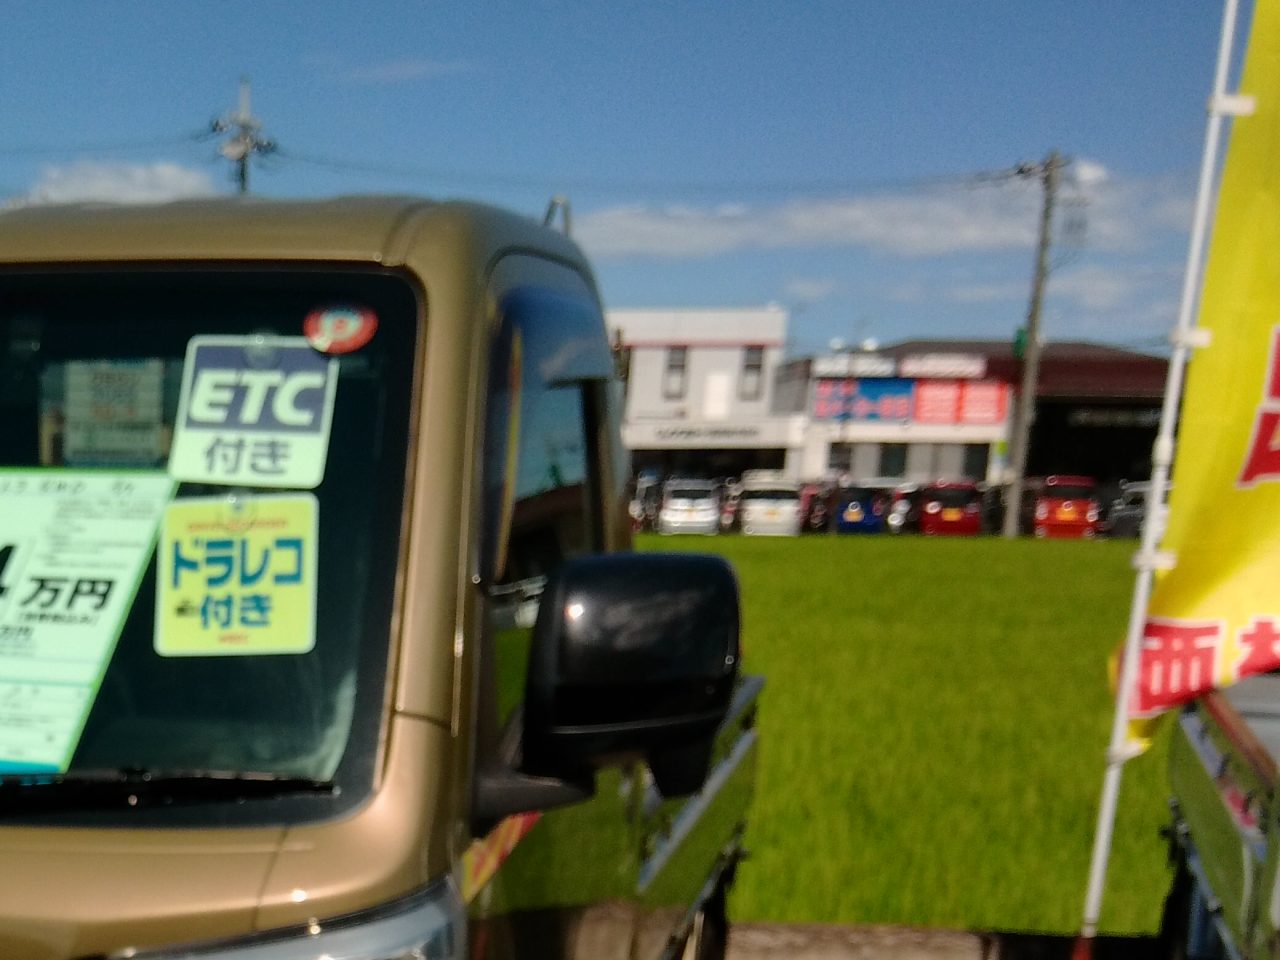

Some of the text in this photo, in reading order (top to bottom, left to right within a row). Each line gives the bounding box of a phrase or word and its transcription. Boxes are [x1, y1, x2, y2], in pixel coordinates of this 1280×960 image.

[188, 369, 326, 426] ETC
[204, 437, 291, 475] 付き
[172, 537, 306, 589] ドラレコ
[200, 594, 273, 629] 付き
